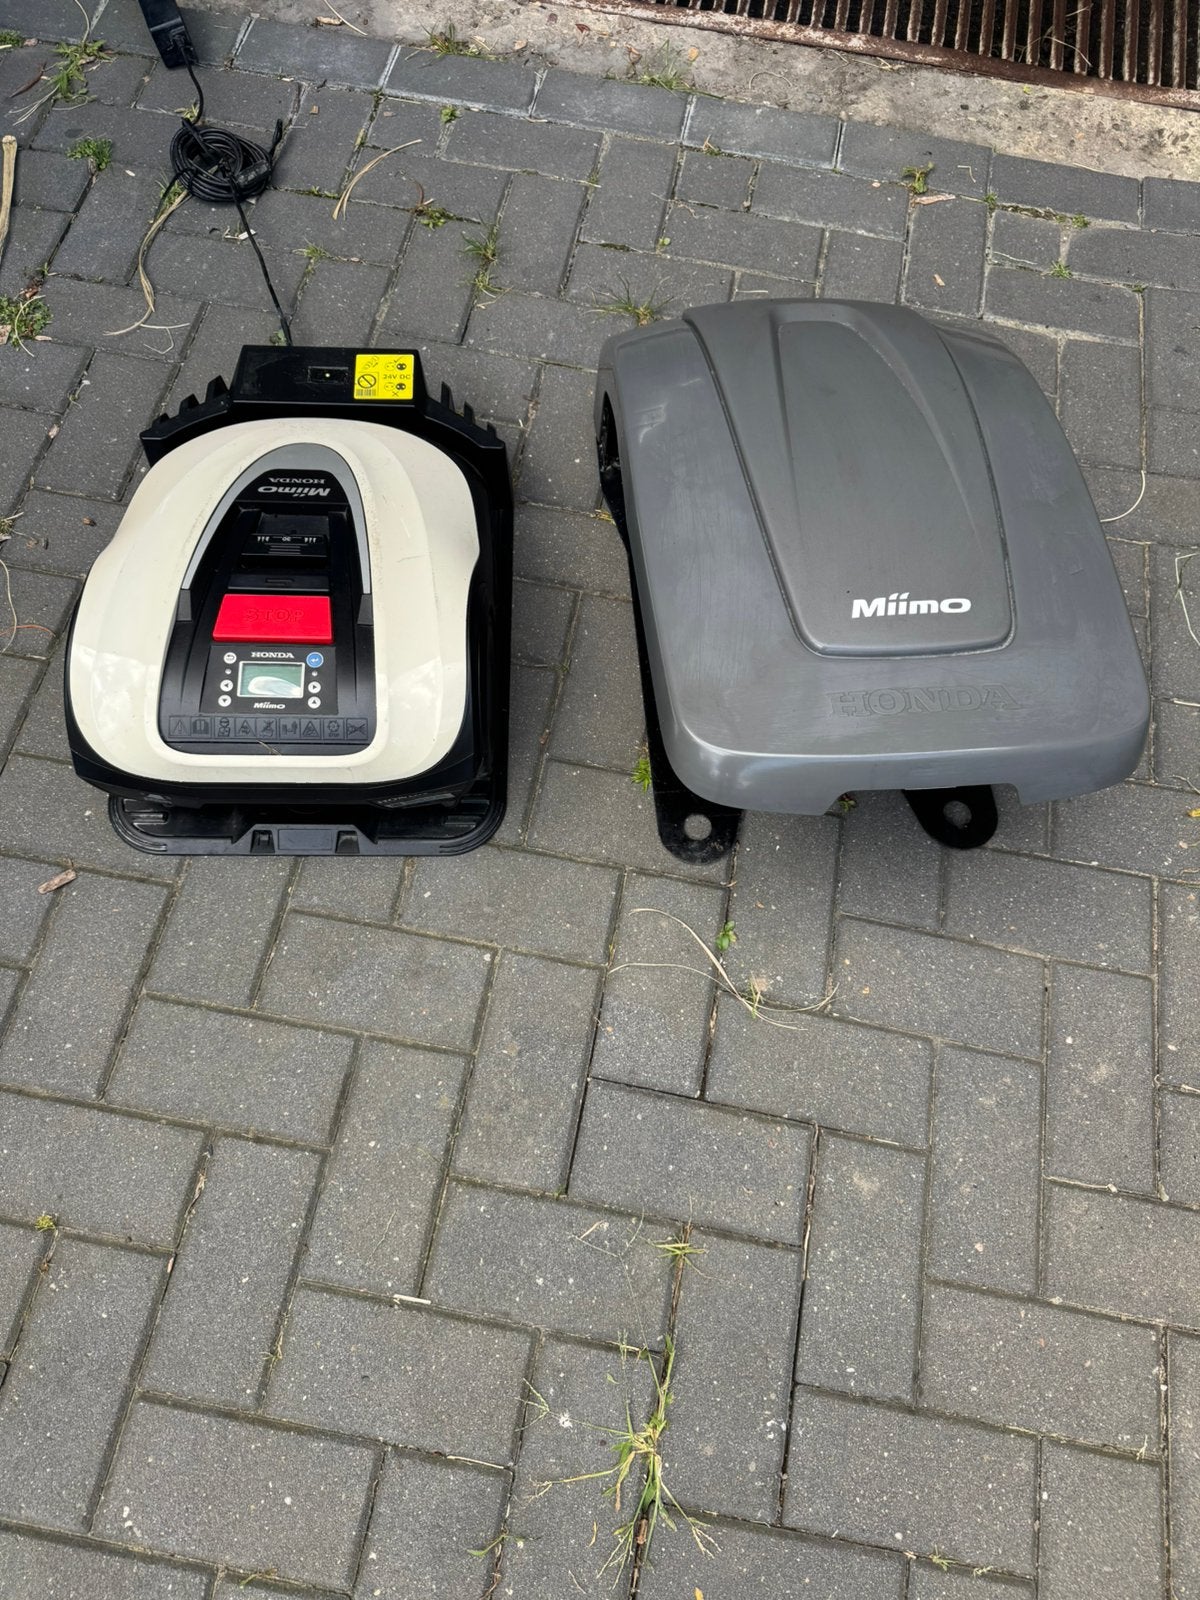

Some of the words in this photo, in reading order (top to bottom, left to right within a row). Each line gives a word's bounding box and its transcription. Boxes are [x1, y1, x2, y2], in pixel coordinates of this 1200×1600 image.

[257, 485, 331, 497] Miimo
[851, 592, 972, 619] Miimo
[244, 607, 305, 622] STOP
[251, 651, 295, 659] HONDA
[253, 702, 286, 710] Miimo
[826, 683, 1024, 717] HONDA
